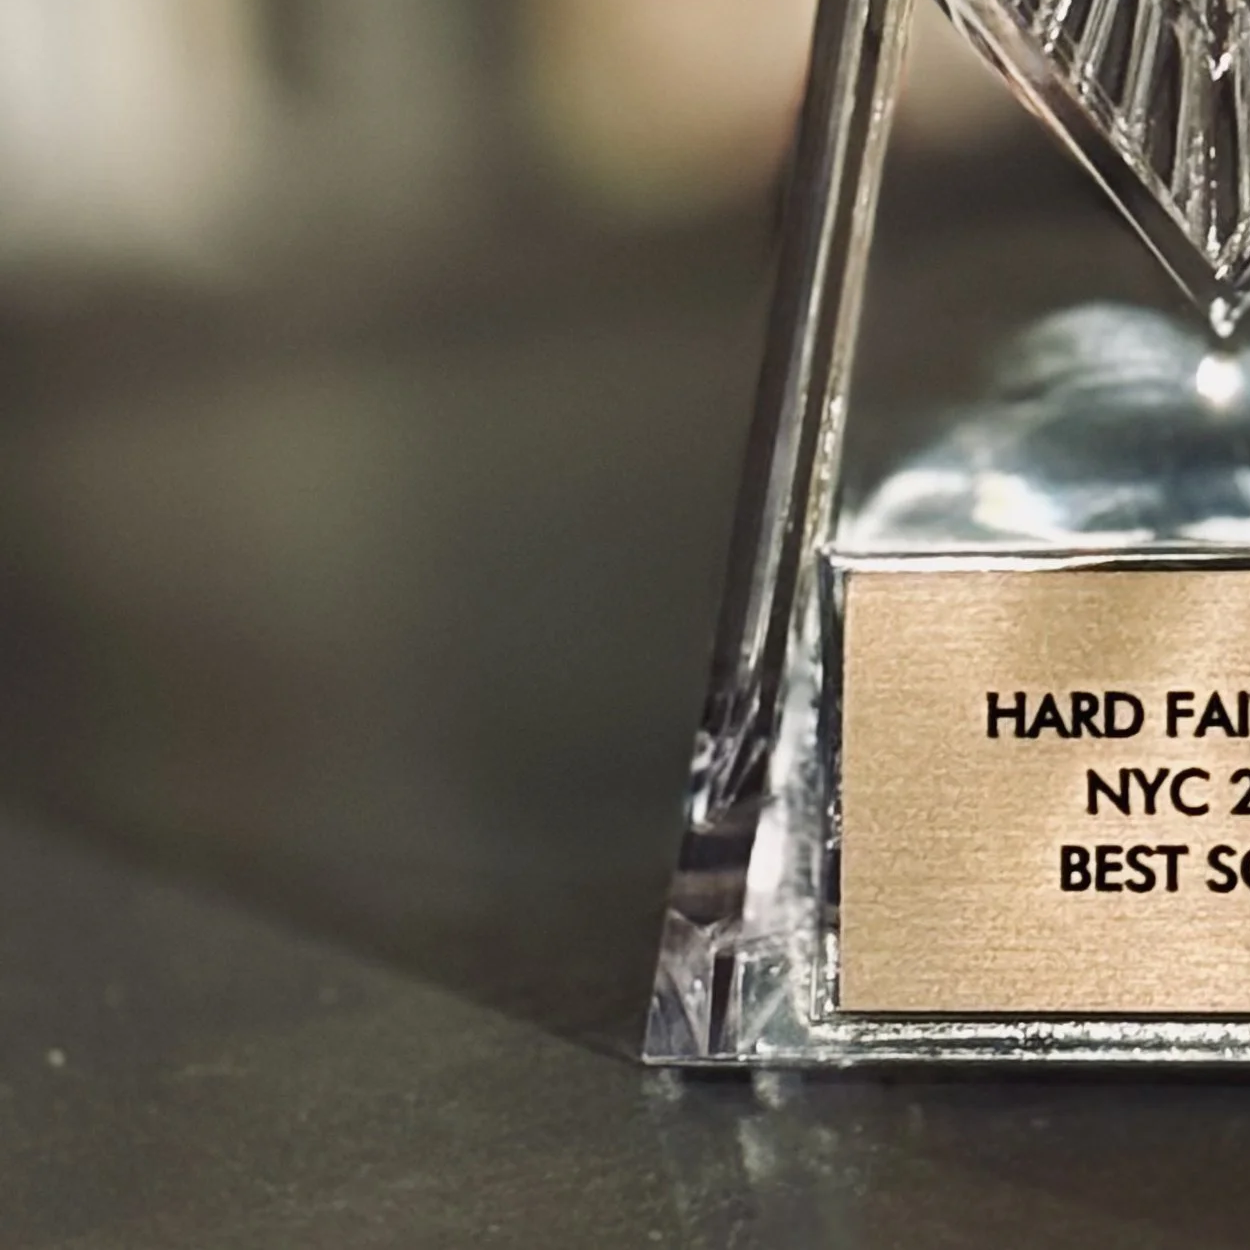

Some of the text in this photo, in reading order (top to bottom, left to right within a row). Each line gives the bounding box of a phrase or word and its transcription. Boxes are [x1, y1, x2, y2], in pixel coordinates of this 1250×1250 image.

[986, 690, 1145, 739] HARD
[1086, 767, 1210, 817] NYC
[1060, 844, 1189, 894] BEST
